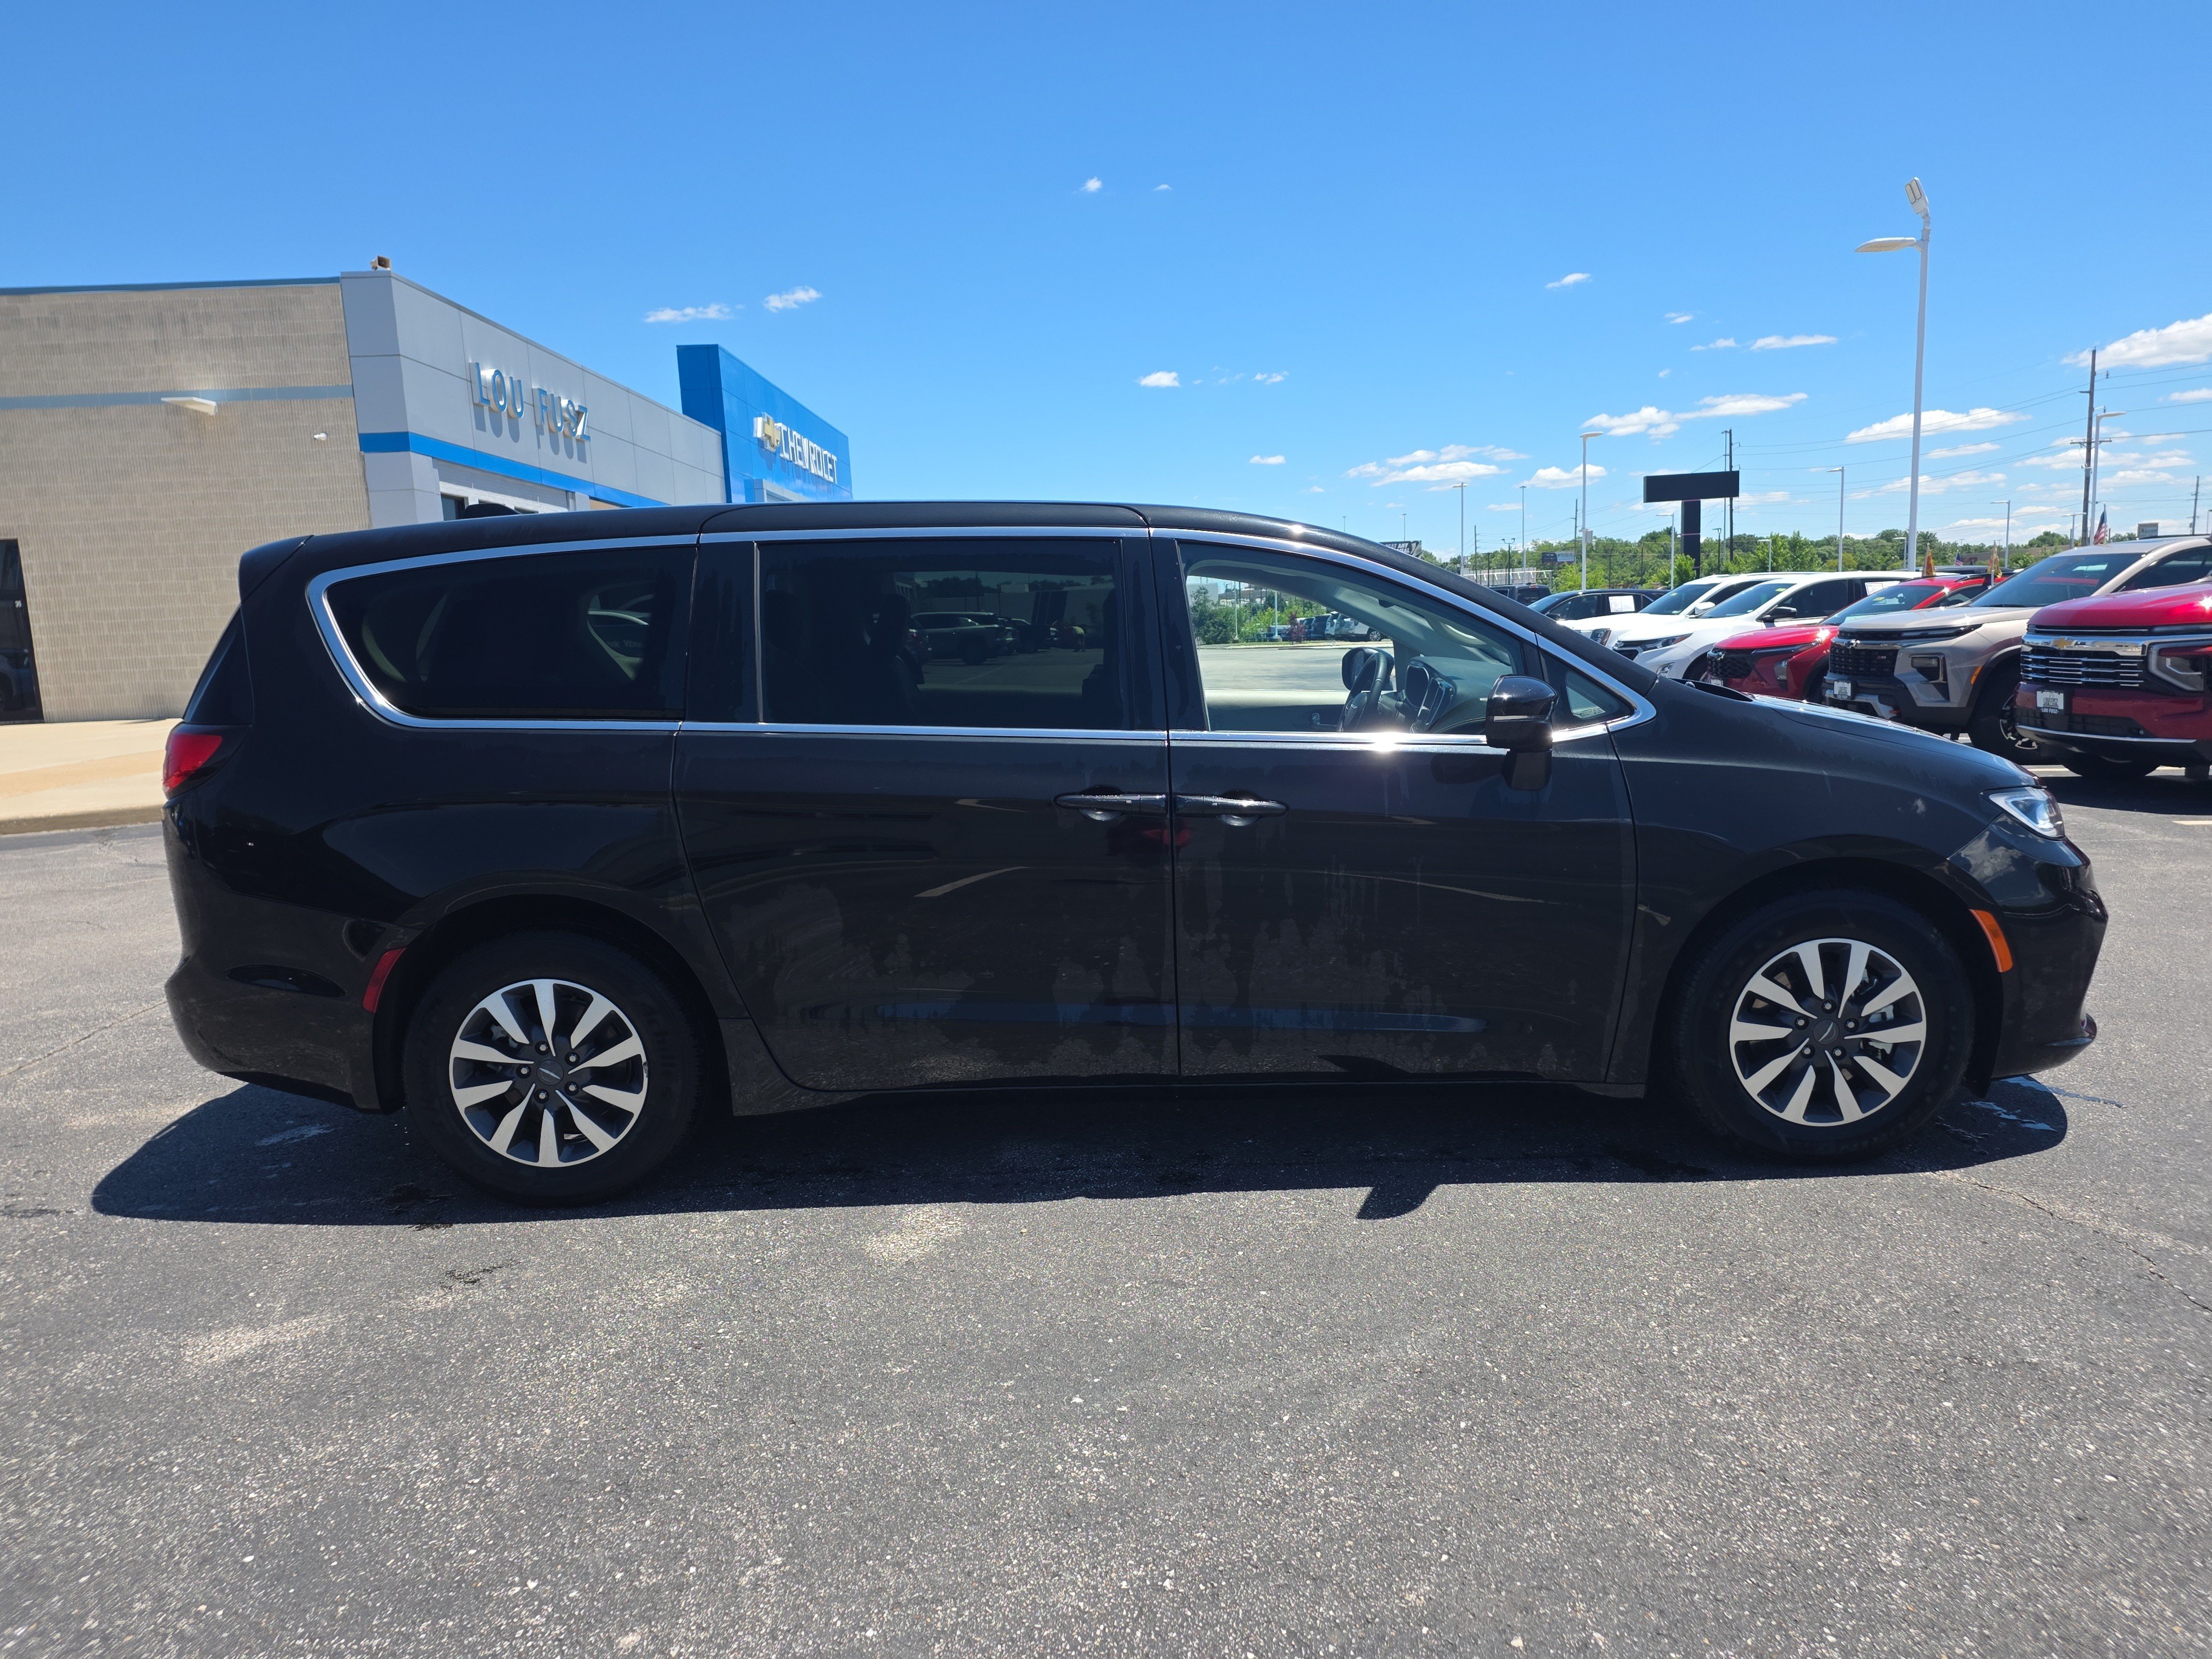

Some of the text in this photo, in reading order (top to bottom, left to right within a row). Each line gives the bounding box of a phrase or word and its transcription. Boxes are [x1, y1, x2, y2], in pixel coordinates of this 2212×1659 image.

[470, 362, 591, 442] LOU FUSZ
[779, 423, 837, 484] CHEVROLET
